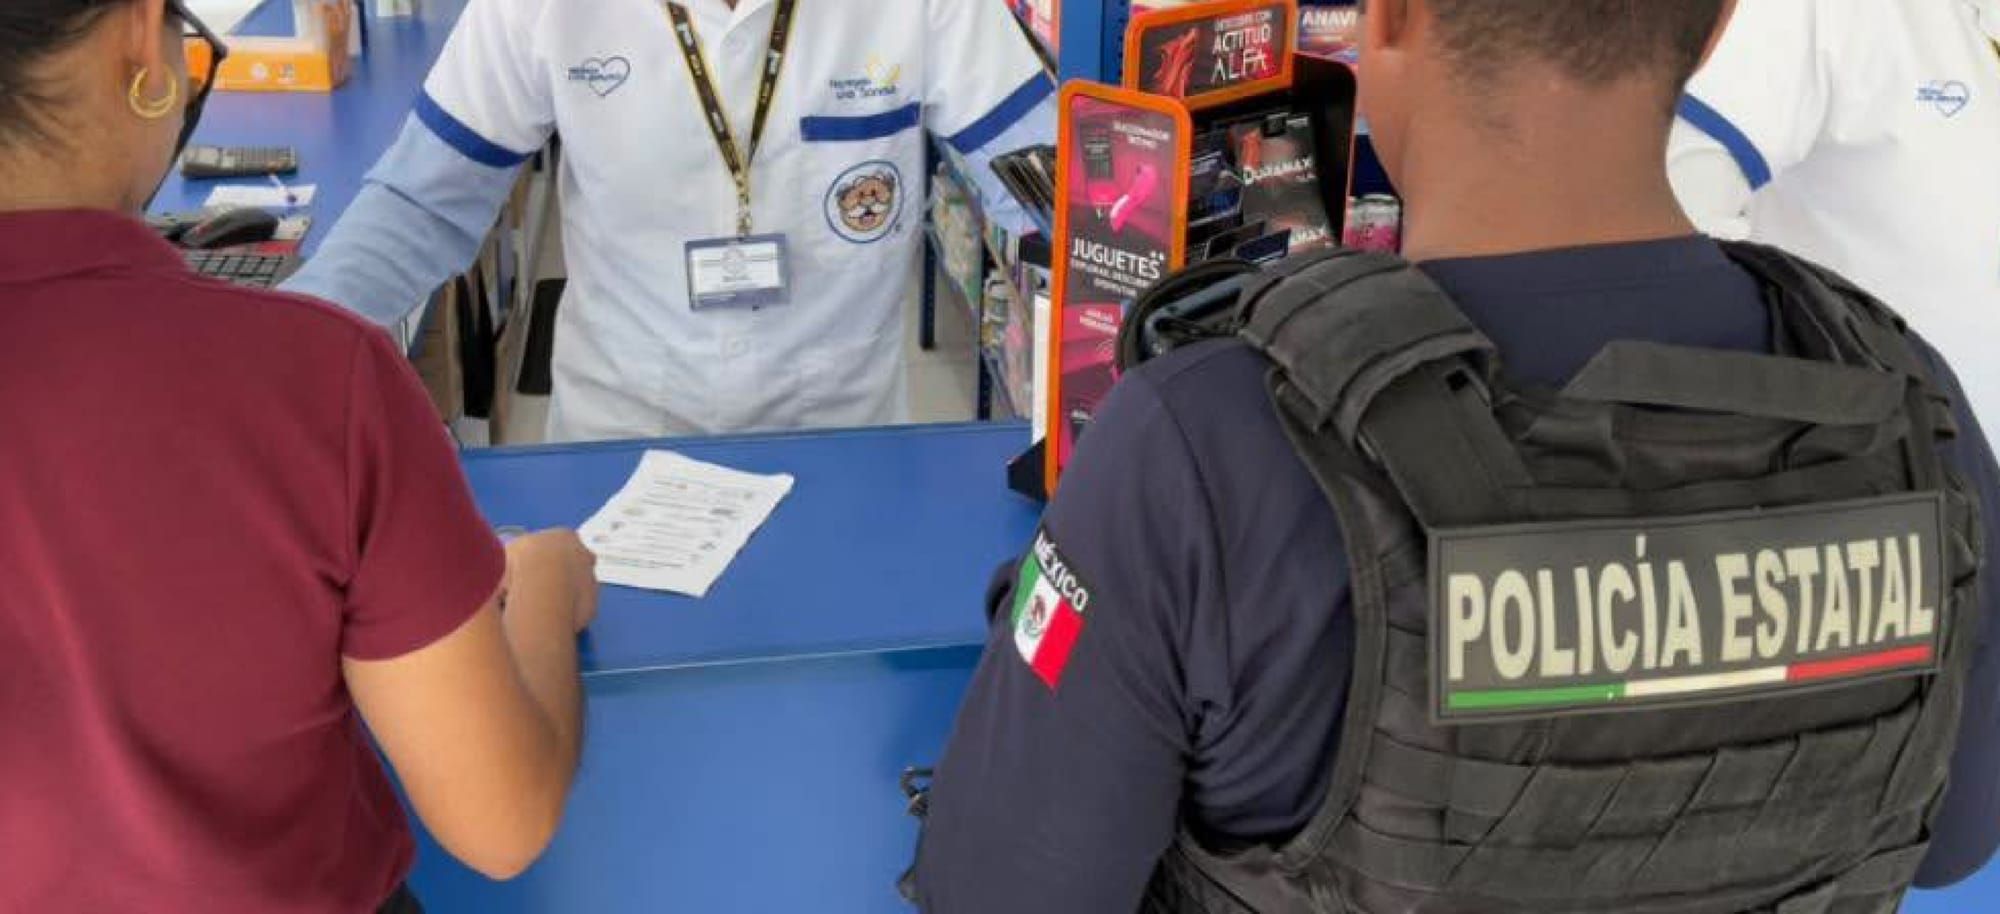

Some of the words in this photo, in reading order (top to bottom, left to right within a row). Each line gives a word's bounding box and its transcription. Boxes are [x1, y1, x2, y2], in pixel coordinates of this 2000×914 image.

[1212, 23, 1271, 55] ACTITUD
[1210, 47, 1267, 84] ALFA
[1073, 238, 1160, 279] JUGUETES
[1447, 535, 1702, 681] POLICÍA
[1715, 533, 1935, 662] ESTATAL
